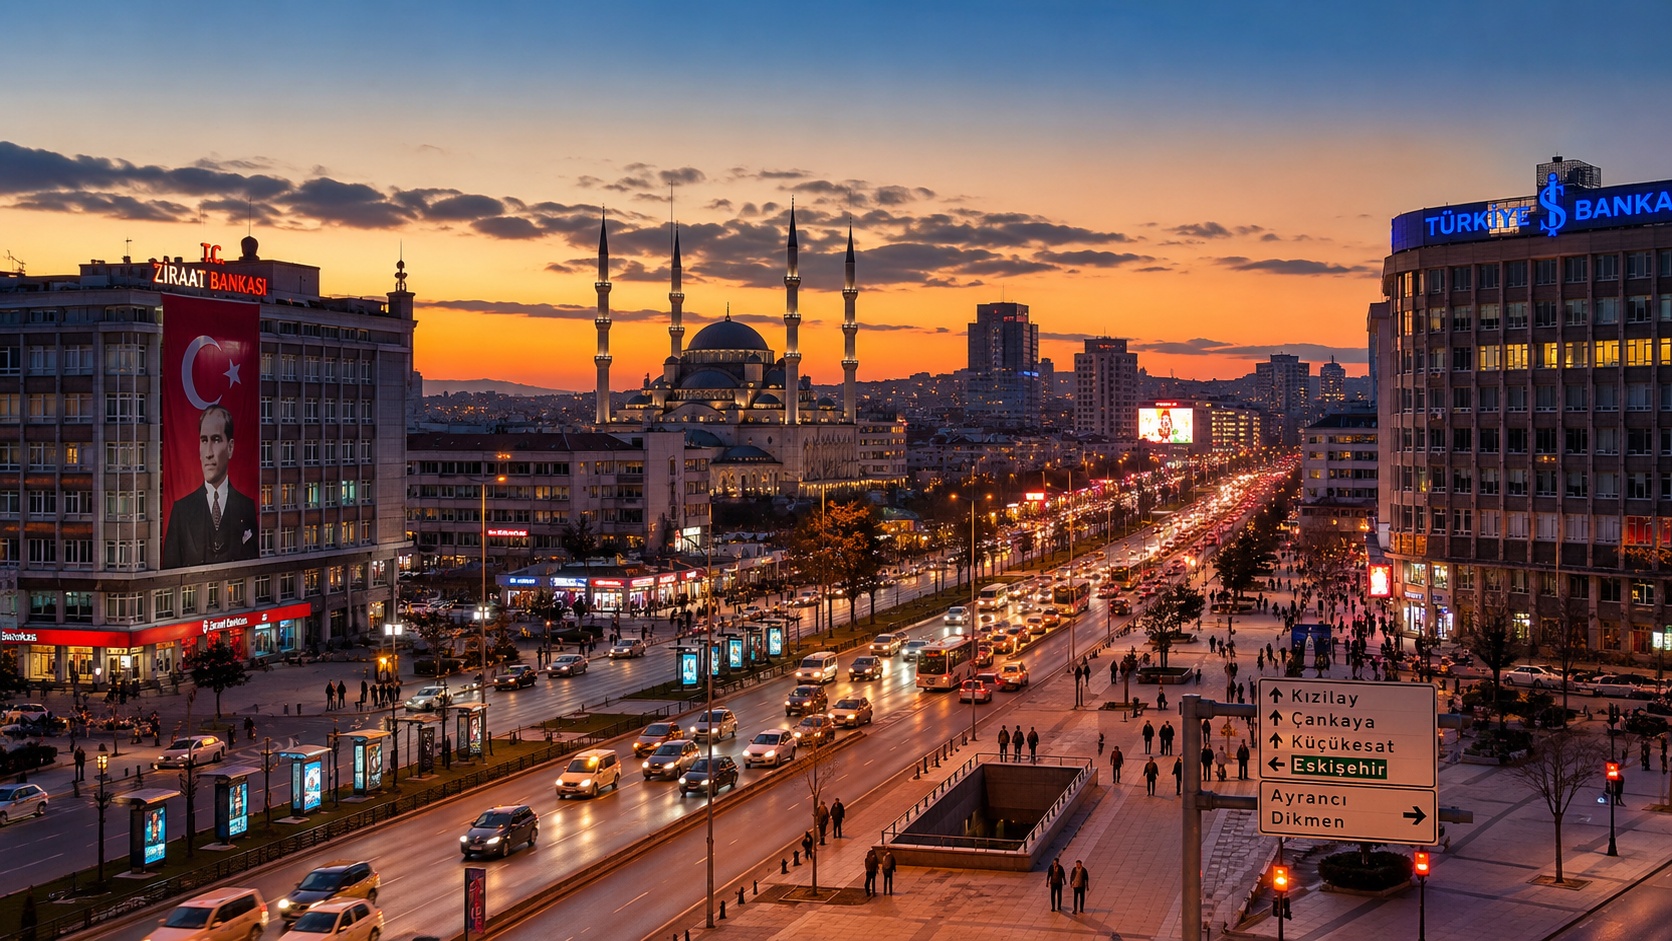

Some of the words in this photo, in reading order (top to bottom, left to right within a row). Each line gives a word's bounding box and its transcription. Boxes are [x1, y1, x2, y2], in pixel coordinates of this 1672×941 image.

[1425, 203, 1530, 236] TÜRKİYE
[153, 261, 206, 289] ZİRAAT
[210, 271, 267, 296] BANKASI
[1292, 712, 1375, 731] Çankaya
[1292, 734, 1395, 753] Küçükesat
[1293, 758, 1385, 777] Eskişehir
[1271, 788, 1347, 806] Ayrancı
[1271, 811, 1344, 828] Dikmen
